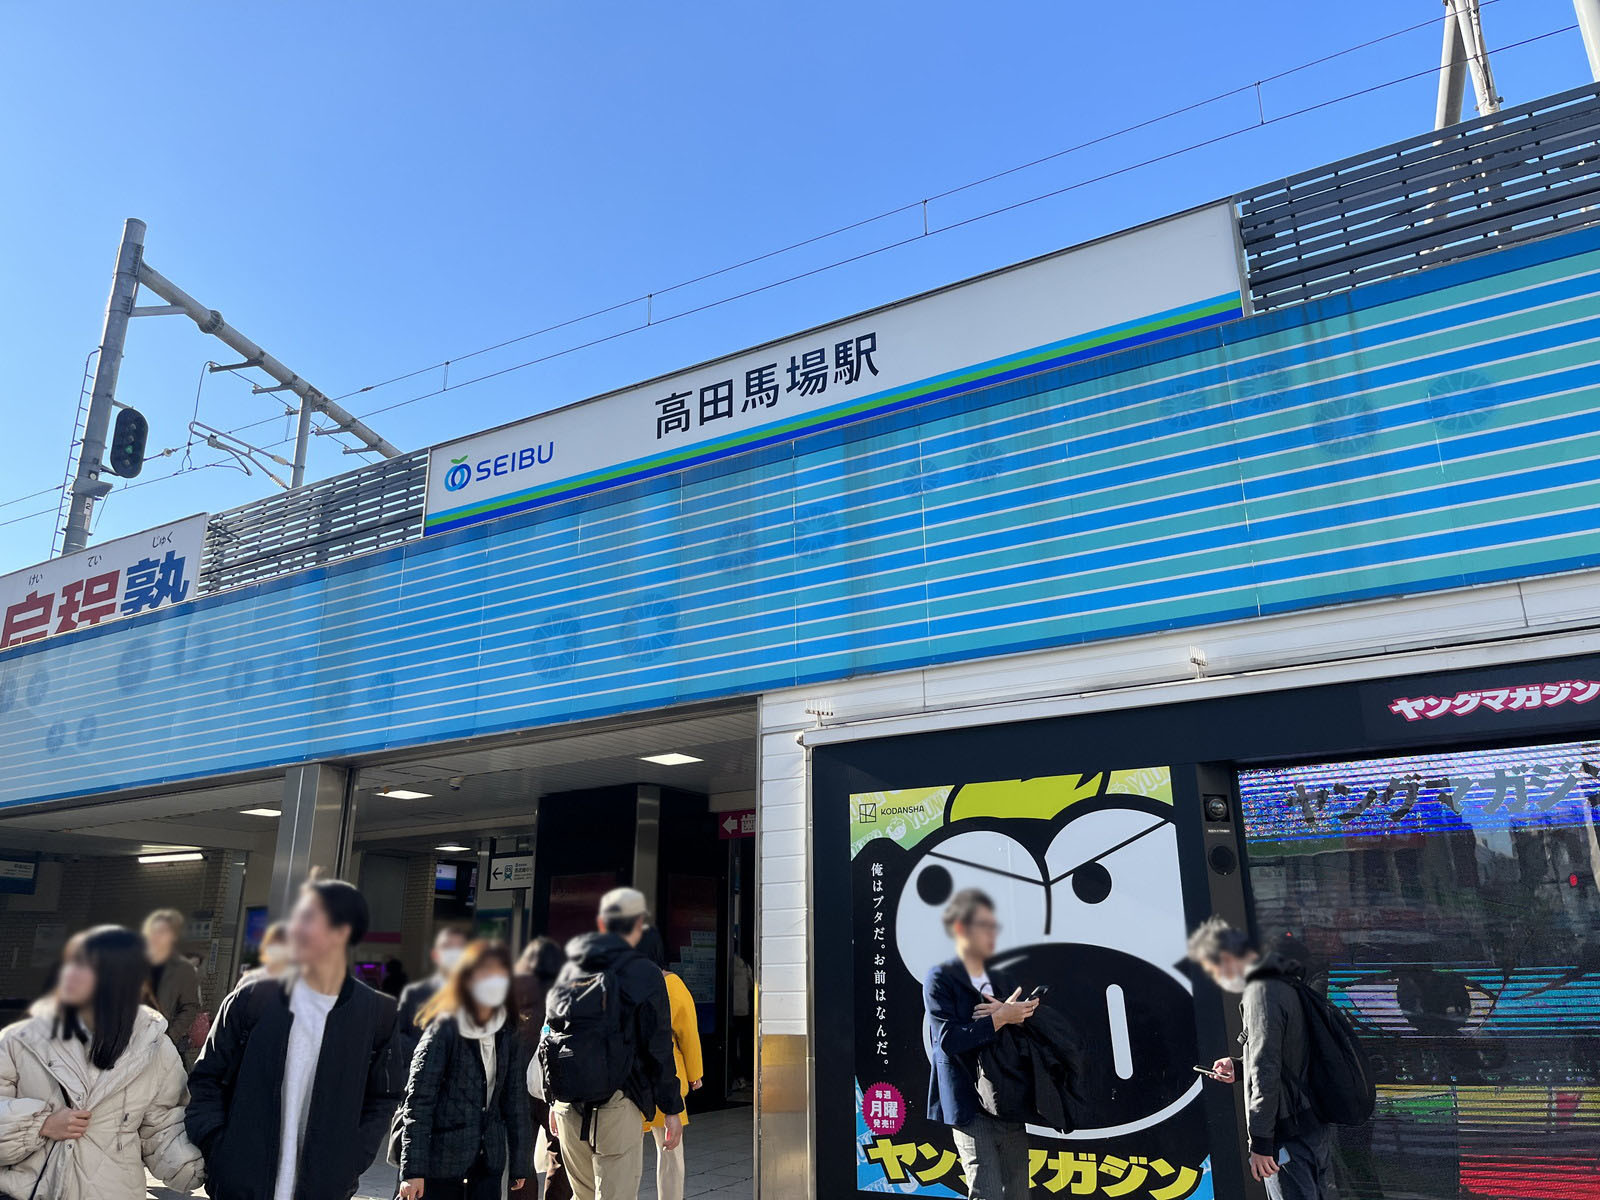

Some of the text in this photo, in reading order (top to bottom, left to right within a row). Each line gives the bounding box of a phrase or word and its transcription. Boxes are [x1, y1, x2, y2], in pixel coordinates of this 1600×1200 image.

[654, 331, 879, 440] 高田馬場駅
[475, 441, 554, 482] SEIBU
[28, 573, 43, 586] けい
[87, 555, 102, 568] てい
[1390, 681, 1600, 720] ヤングマガジン
[880, 805, 925, 815] KODANSHA
[871, 862, 889, 1065] 俺はブタだ。お前はなんだ。
[870, 1101, 898, 1118] 月曜
[875, 1090, 891, 1099] 毎週
